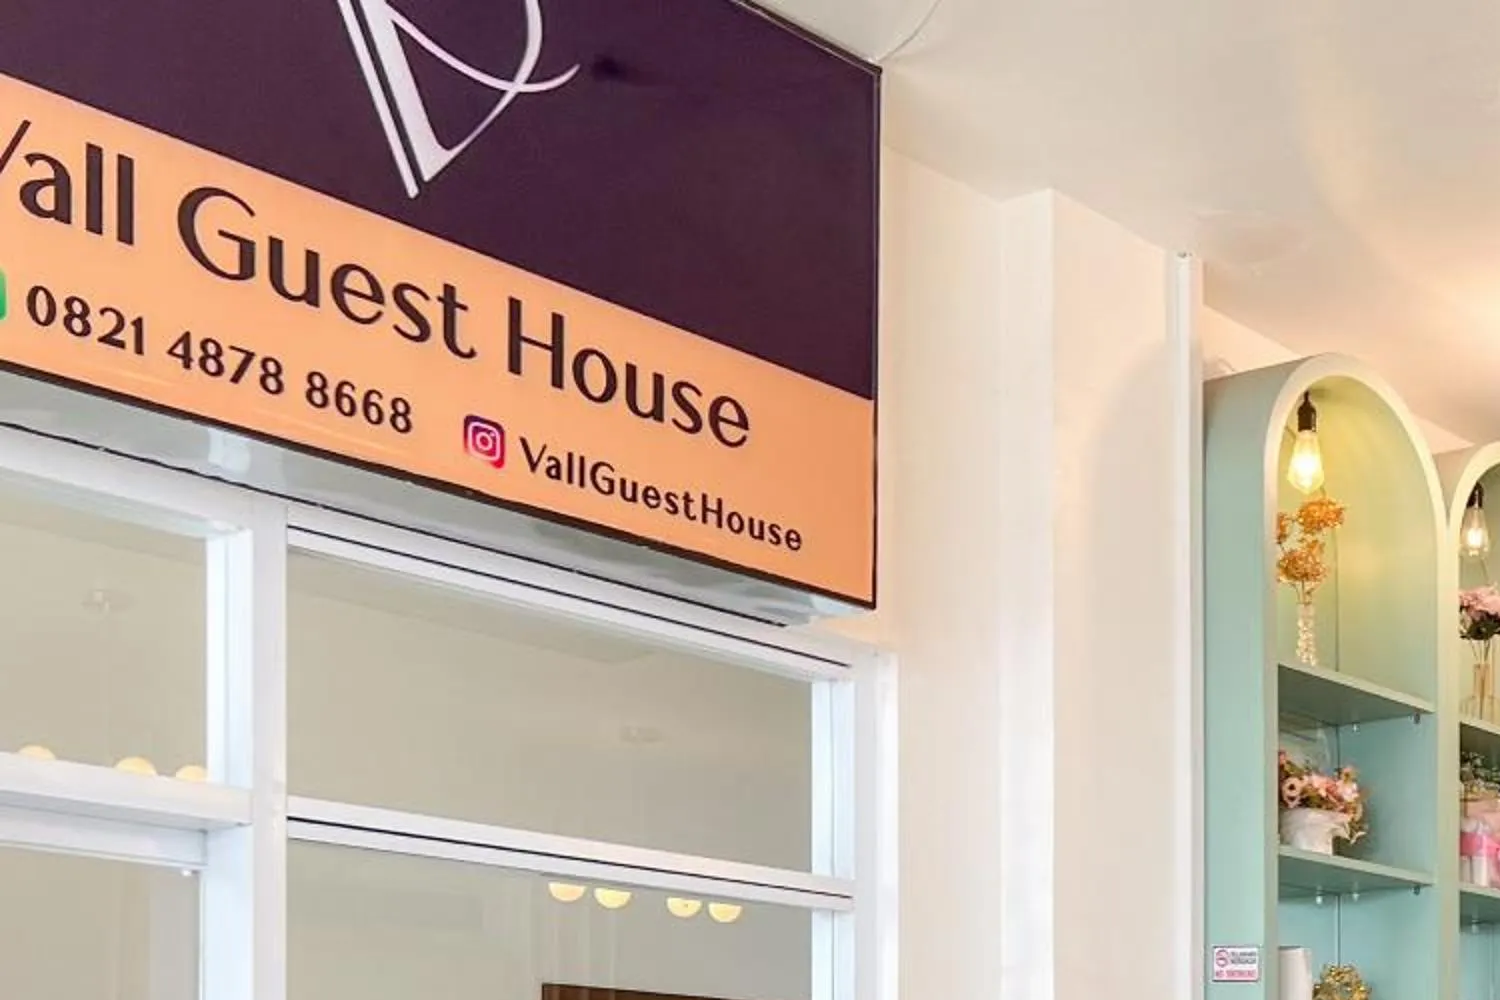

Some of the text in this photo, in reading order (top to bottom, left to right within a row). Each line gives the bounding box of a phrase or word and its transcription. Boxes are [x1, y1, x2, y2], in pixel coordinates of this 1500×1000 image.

[26, 285, 413, 434] 0821 4878 8668
[177, 186, 477, 360] Guest
[507, 295, 750, 449] House
[519, 436, 803, 552] VallGuestHouse
